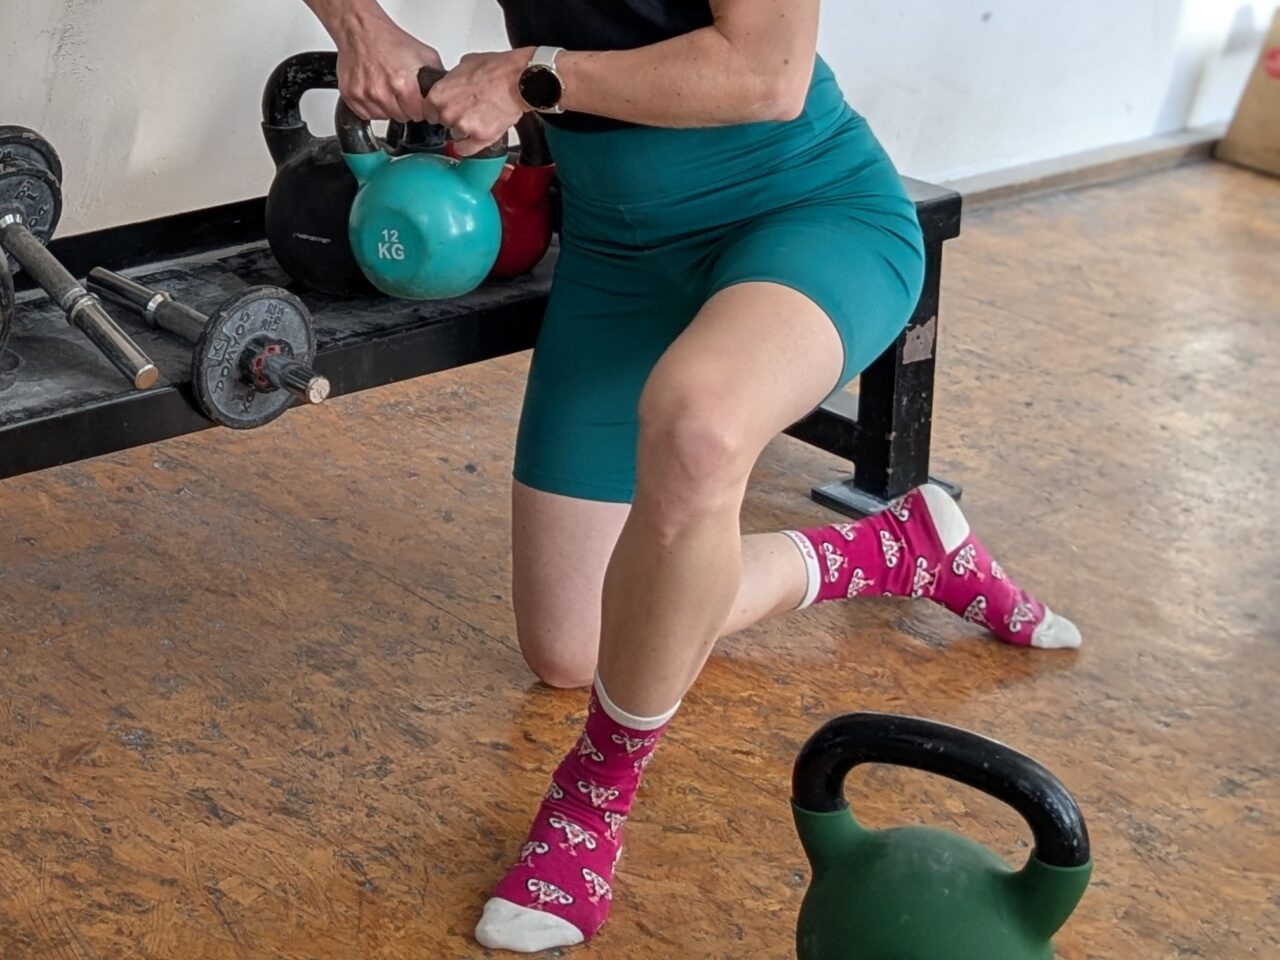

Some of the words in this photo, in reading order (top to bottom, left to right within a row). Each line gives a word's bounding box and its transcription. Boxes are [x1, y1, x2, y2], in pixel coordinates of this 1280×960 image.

[381, 228, 400, 243] 12
[377, 242, 406, 260] KG
[213, 311, 251, 394] DOMYOS
